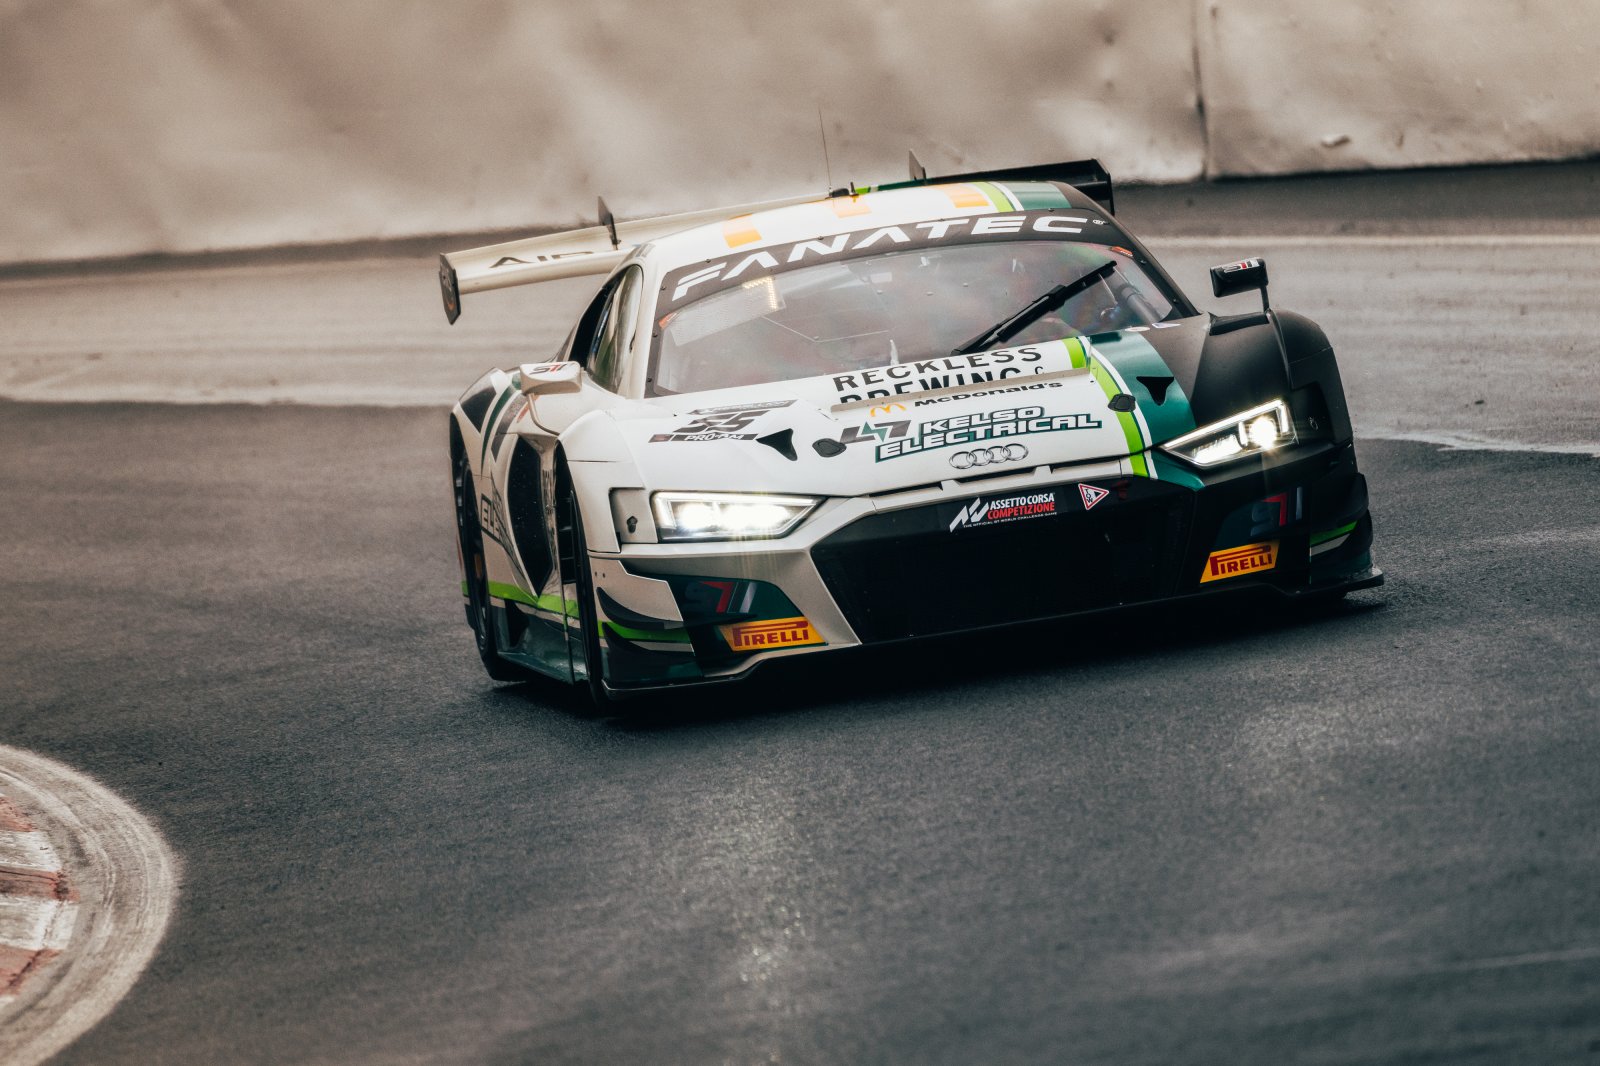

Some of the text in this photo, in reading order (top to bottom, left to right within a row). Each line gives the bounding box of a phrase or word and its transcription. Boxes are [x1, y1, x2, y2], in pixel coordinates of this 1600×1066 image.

[672, 215, 1089, 302] FANATEC
[832, 347, 1042, 392] RECKLESS
[914, 381, 1064, 407] McDonald's
[921, 405, 1044, 434] KELSO
[876, 413, 1101, 462] ELECTRICAL
[987, 501, 1056, 520] COMPETIZIONE
[990, 492, 1055, 511] ASSETTO CORSA
[1209, 544, 1273, 576] PIRELLI
[732, 620, 809, 647] PIRELLI
